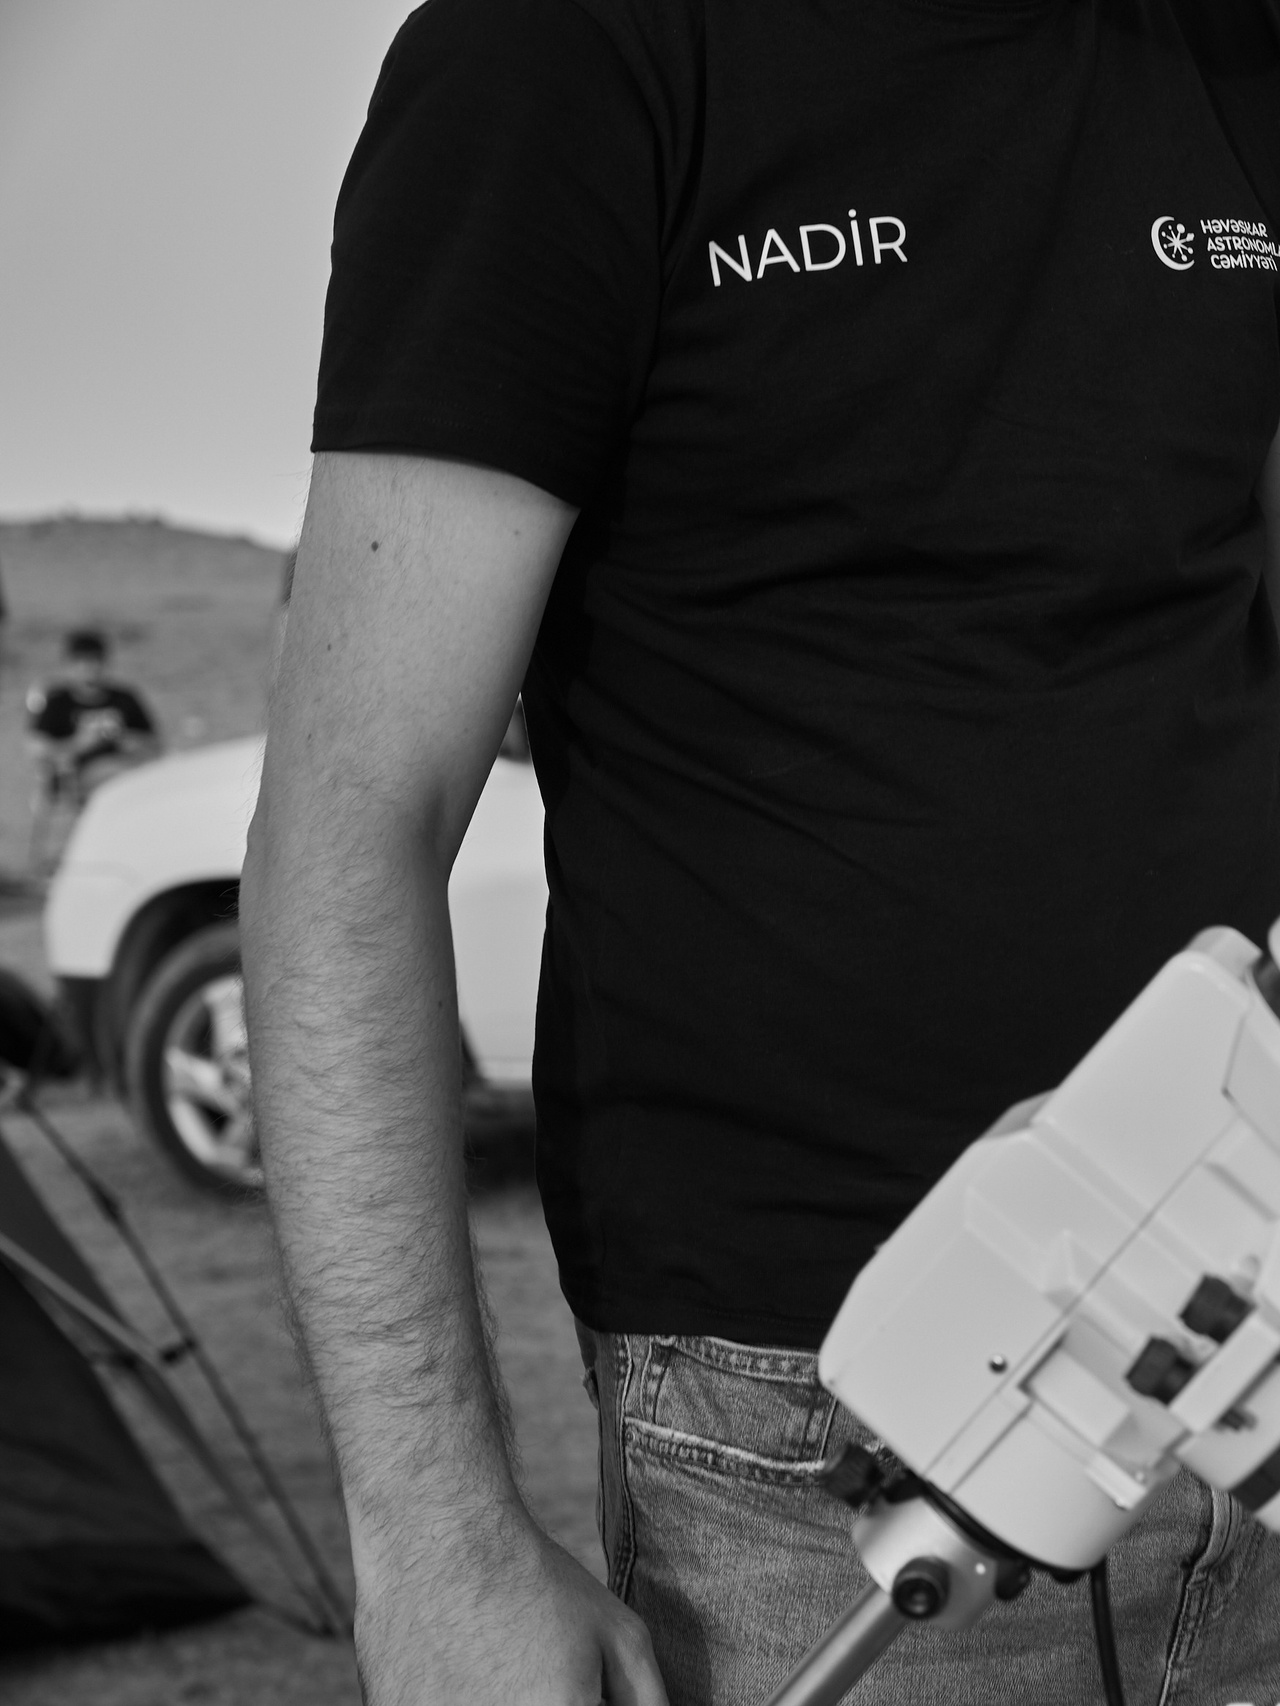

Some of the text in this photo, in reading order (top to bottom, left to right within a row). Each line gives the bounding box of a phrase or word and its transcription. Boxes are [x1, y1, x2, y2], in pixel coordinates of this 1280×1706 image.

[1200, 218, 1268, 238] HƏVƏSKAR
[708, 208, 908, 287] NADİR
[1210, 249, 1279, 272] CƏMİYYƏTİ
